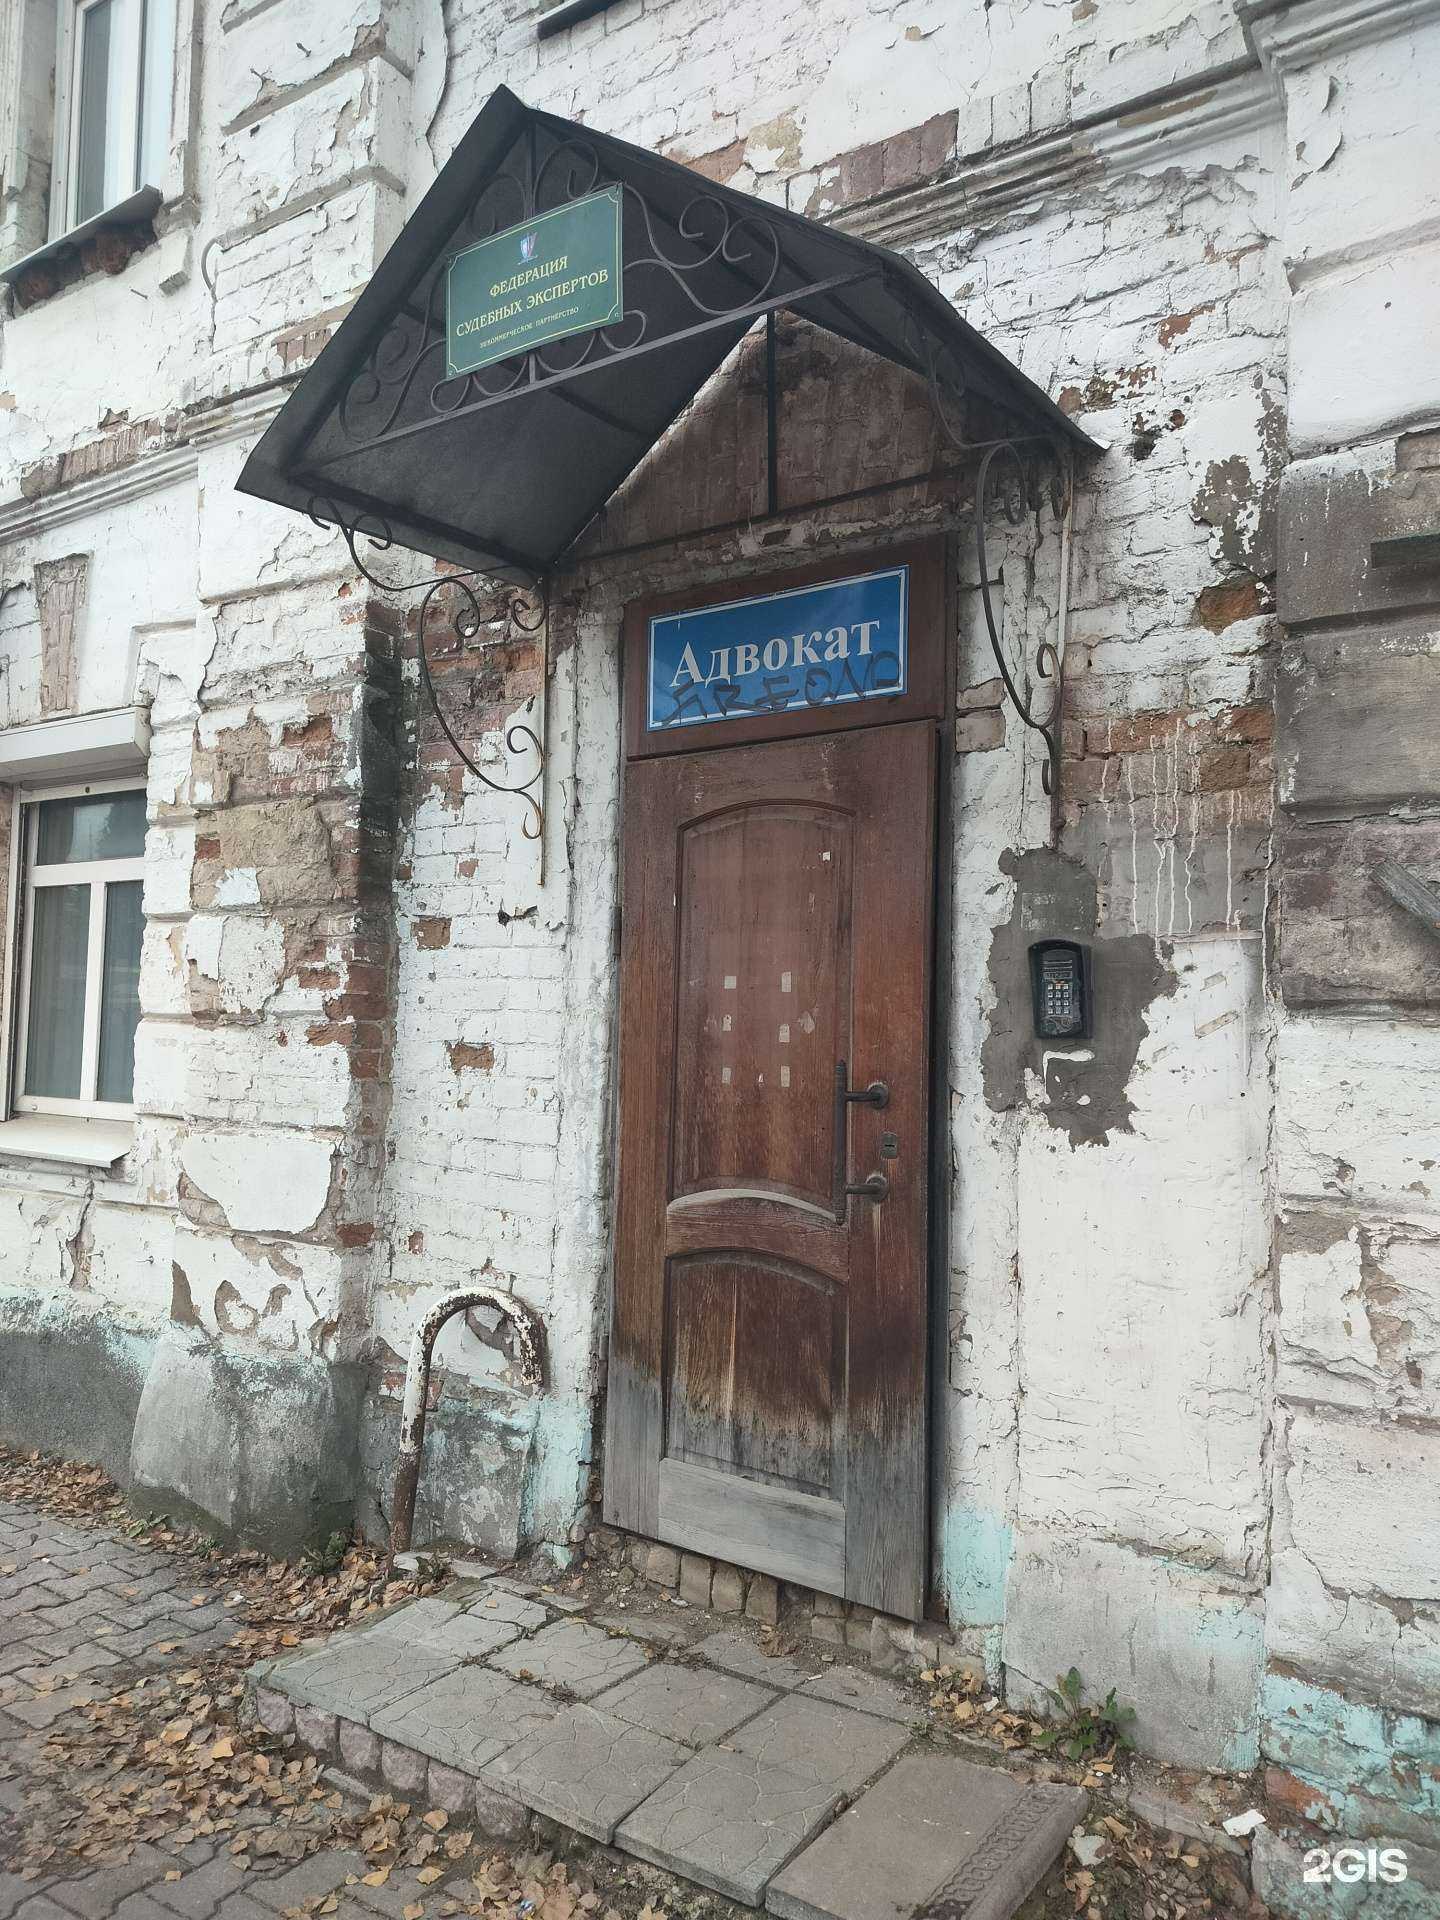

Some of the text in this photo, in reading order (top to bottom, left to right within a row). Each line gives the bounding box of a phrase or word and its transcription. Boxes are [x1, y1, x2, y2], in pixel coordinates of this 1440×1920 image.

[456, 269, 609, 337] СУДЕБНЫХ ЭКСПЕРТОВ
[489, 255, 568, 298] ФЕДЕРАЦИЯ
[535, 307, 579, 328] ПАРТНЕРСТВО
[669, 619, 880, 688] Адвокат
